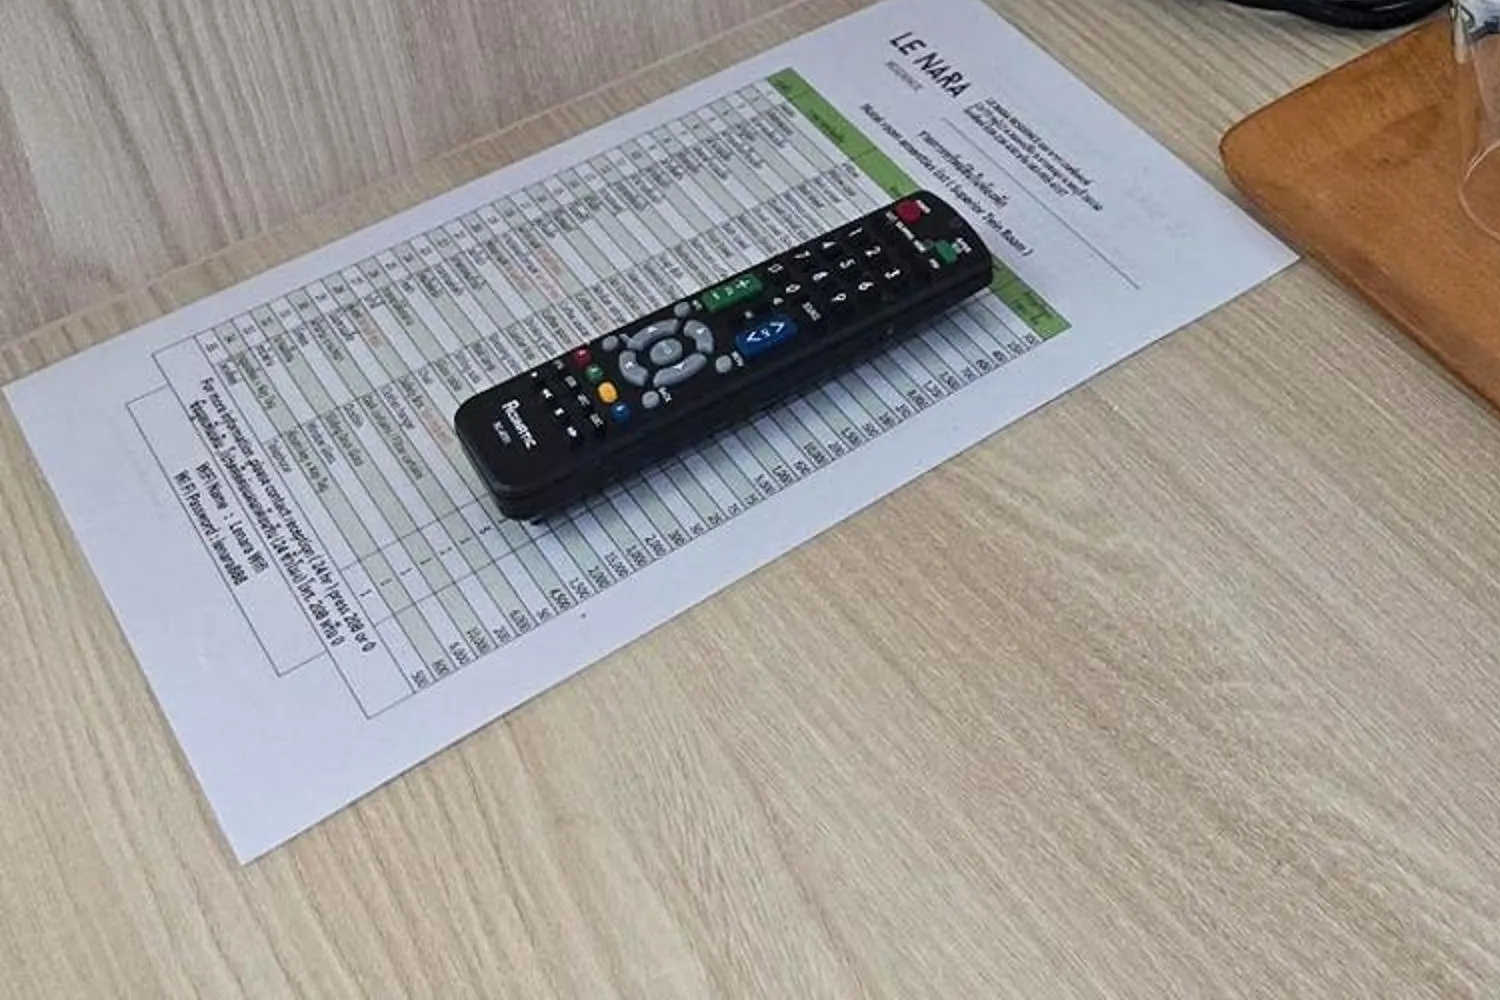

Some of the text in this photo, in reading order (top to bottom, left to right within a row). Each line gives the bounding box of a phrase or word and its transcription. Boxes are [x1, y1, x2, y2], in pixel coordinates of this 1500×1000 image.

[888, 31, 976, 98] LE NARA
[946, 183, 987, 215] Superior
[979, 211, 1006, 232] Twin
[998, 228, 1029, 252] Room
[792, 249, 849, 305] 7 8 9
[818, 238, 876, 293] 4 5 6
[845, 226, 902, 280] 1 2 3
[781, 281, 803, 296] 0
[197, 375, 219, 394] For
[206, 390, 230, 414] more
[218, 409, 258, 457] information
[183, 490, 222, 538] Password
[204, 481, 232, 511] Name
[226, 519, 258, 556] Lenara
[262, 482, 294, 518] contact
[278, 513, 319, 560] reception
[322, 588, 353, 619] press
[351, 630, 371, 647] or
